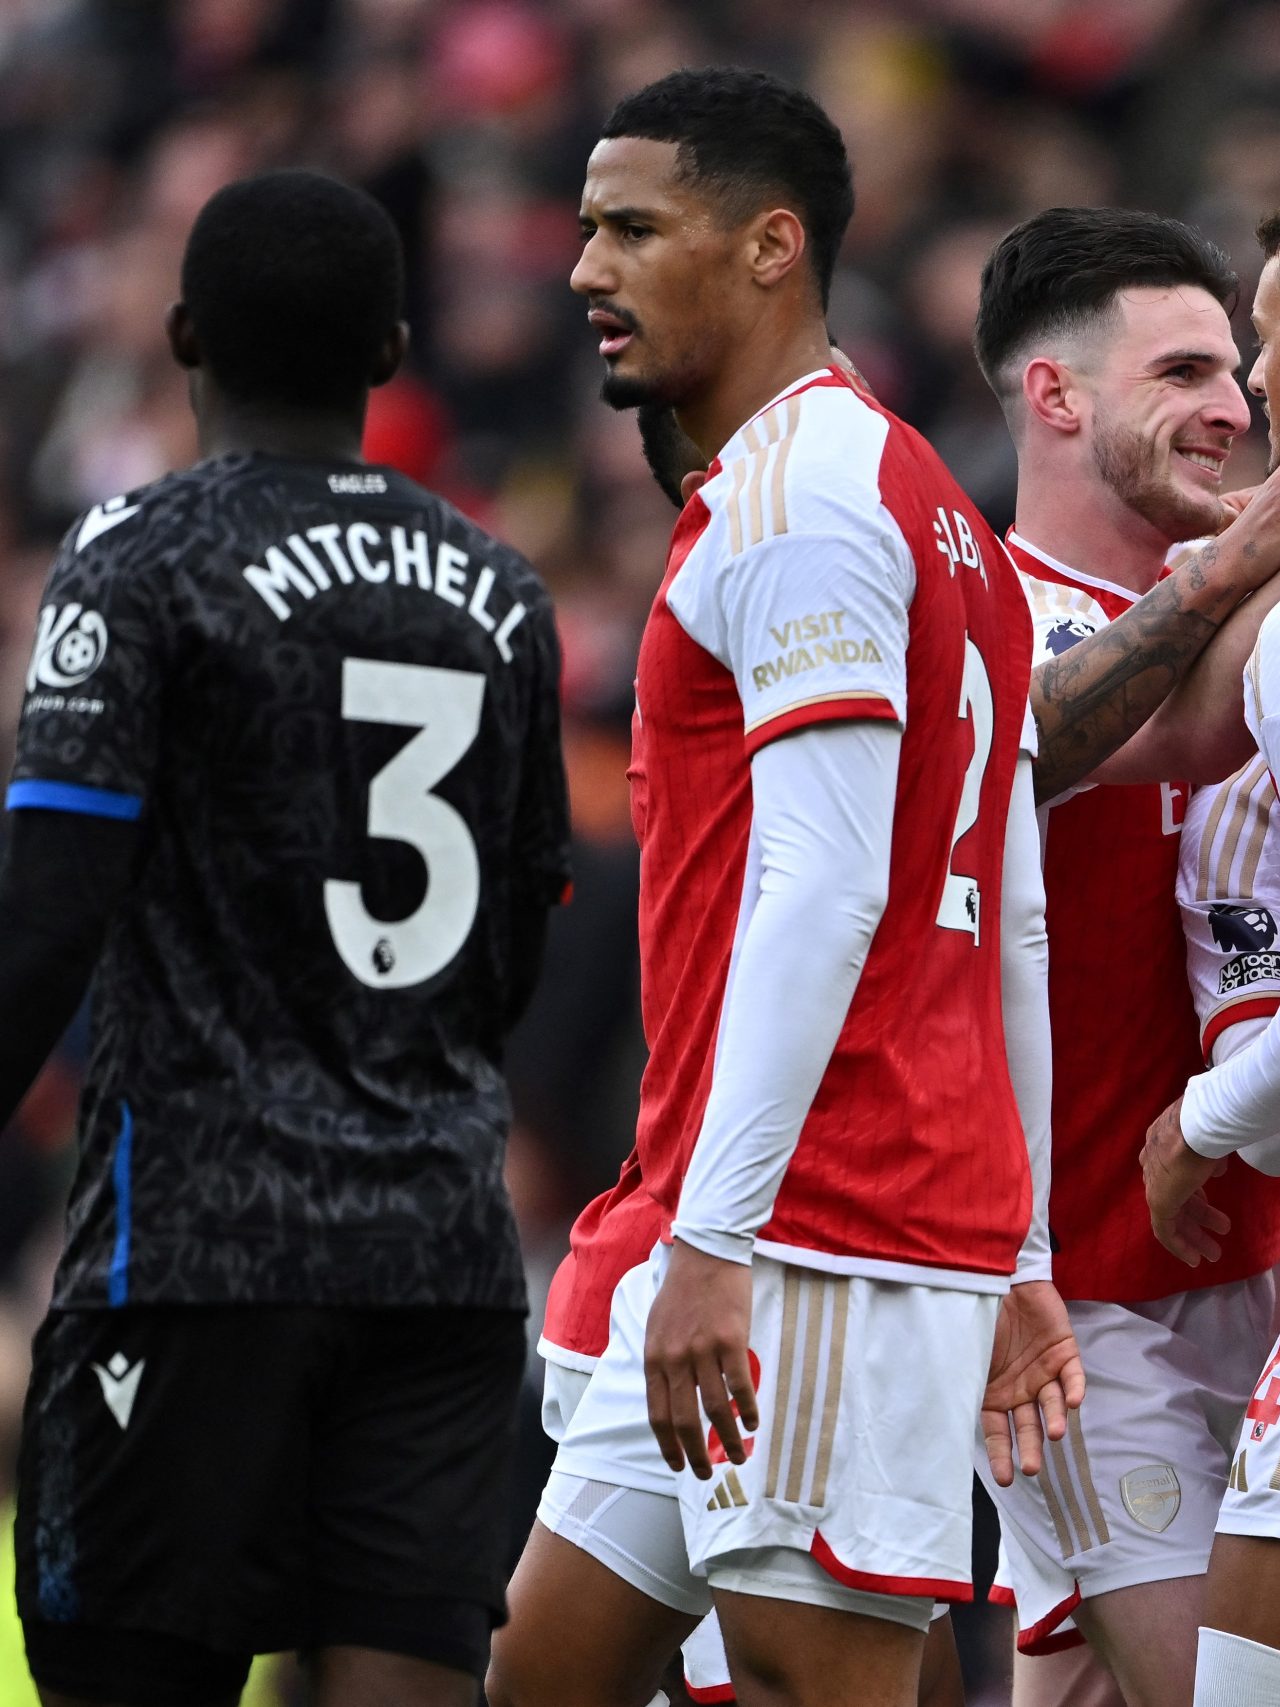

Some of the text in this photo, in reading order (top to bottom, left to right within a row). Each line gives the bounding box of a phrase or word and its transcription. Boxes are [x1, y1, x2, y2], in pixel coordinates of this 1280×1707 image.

[243, 522, 527, 663] MITCHELL
[768, 610, 846, 649] VISIT
[751, 638, 882, 692] RWANDA
[322, 656, 487, 990] 3
[1219, 962, 1241, 984] No
